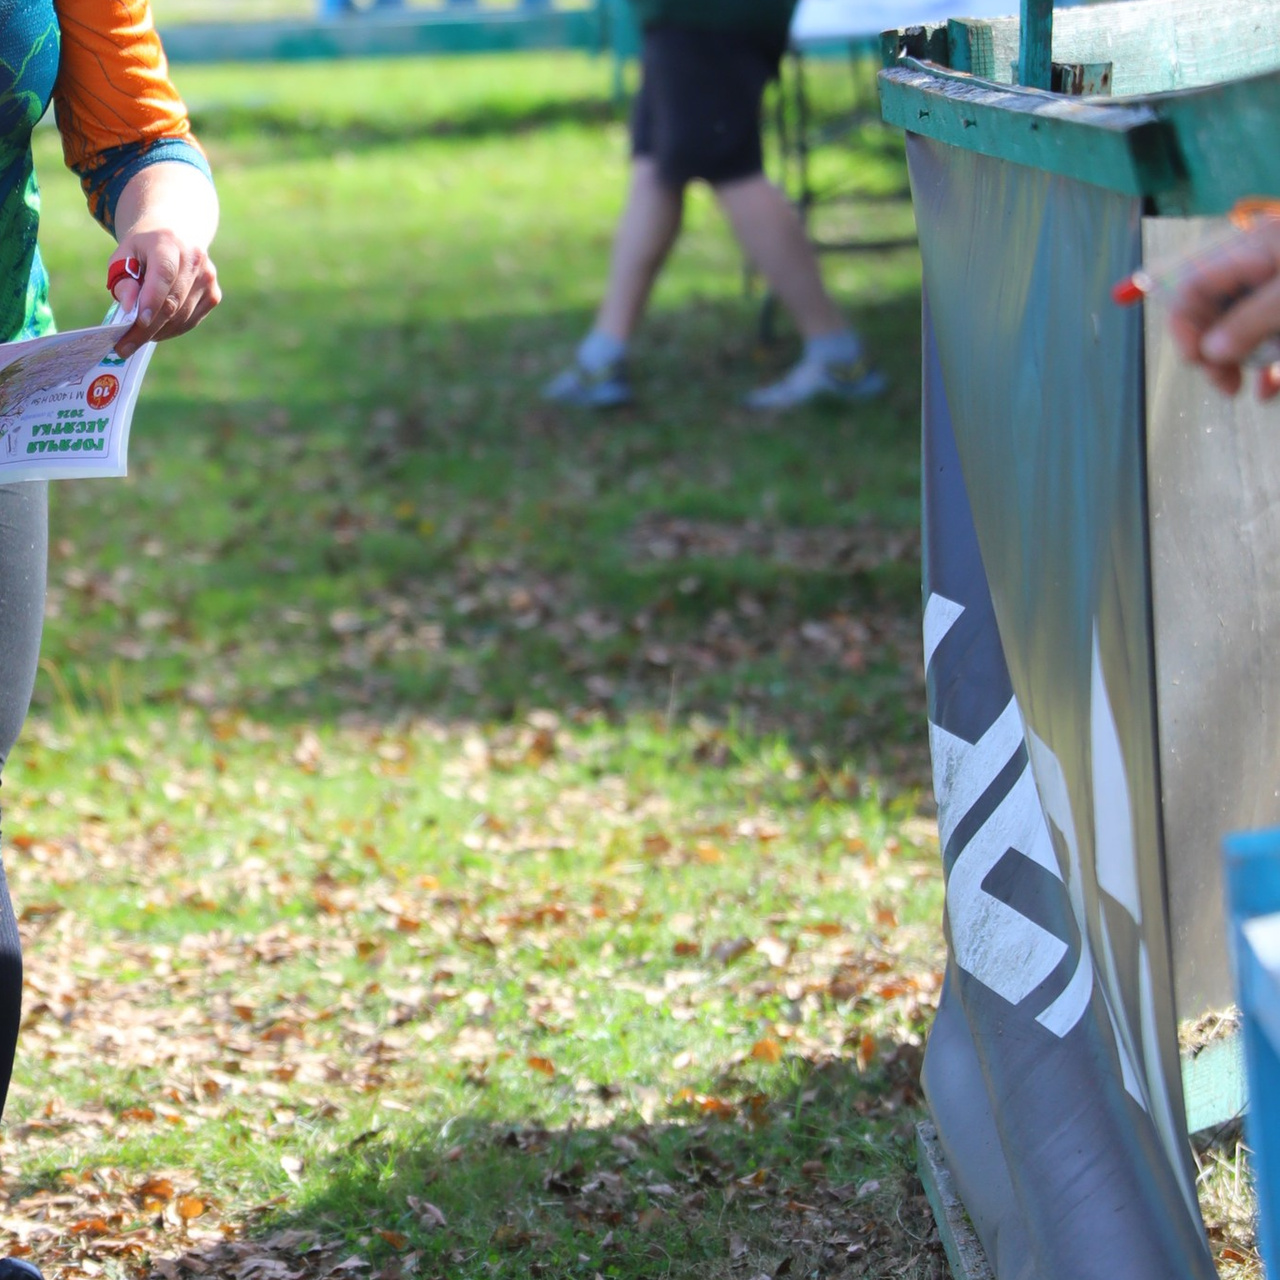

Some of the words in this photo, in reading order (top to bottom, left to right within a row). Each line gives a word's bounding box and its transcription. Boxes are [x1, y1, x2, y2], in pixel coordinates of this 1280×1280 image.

[93, 386, 110, 398] 10
[32, 418, 109, 437] ДЕСЯТКА
[26, 438, 104, 454] ГОРЯЧАЯ
